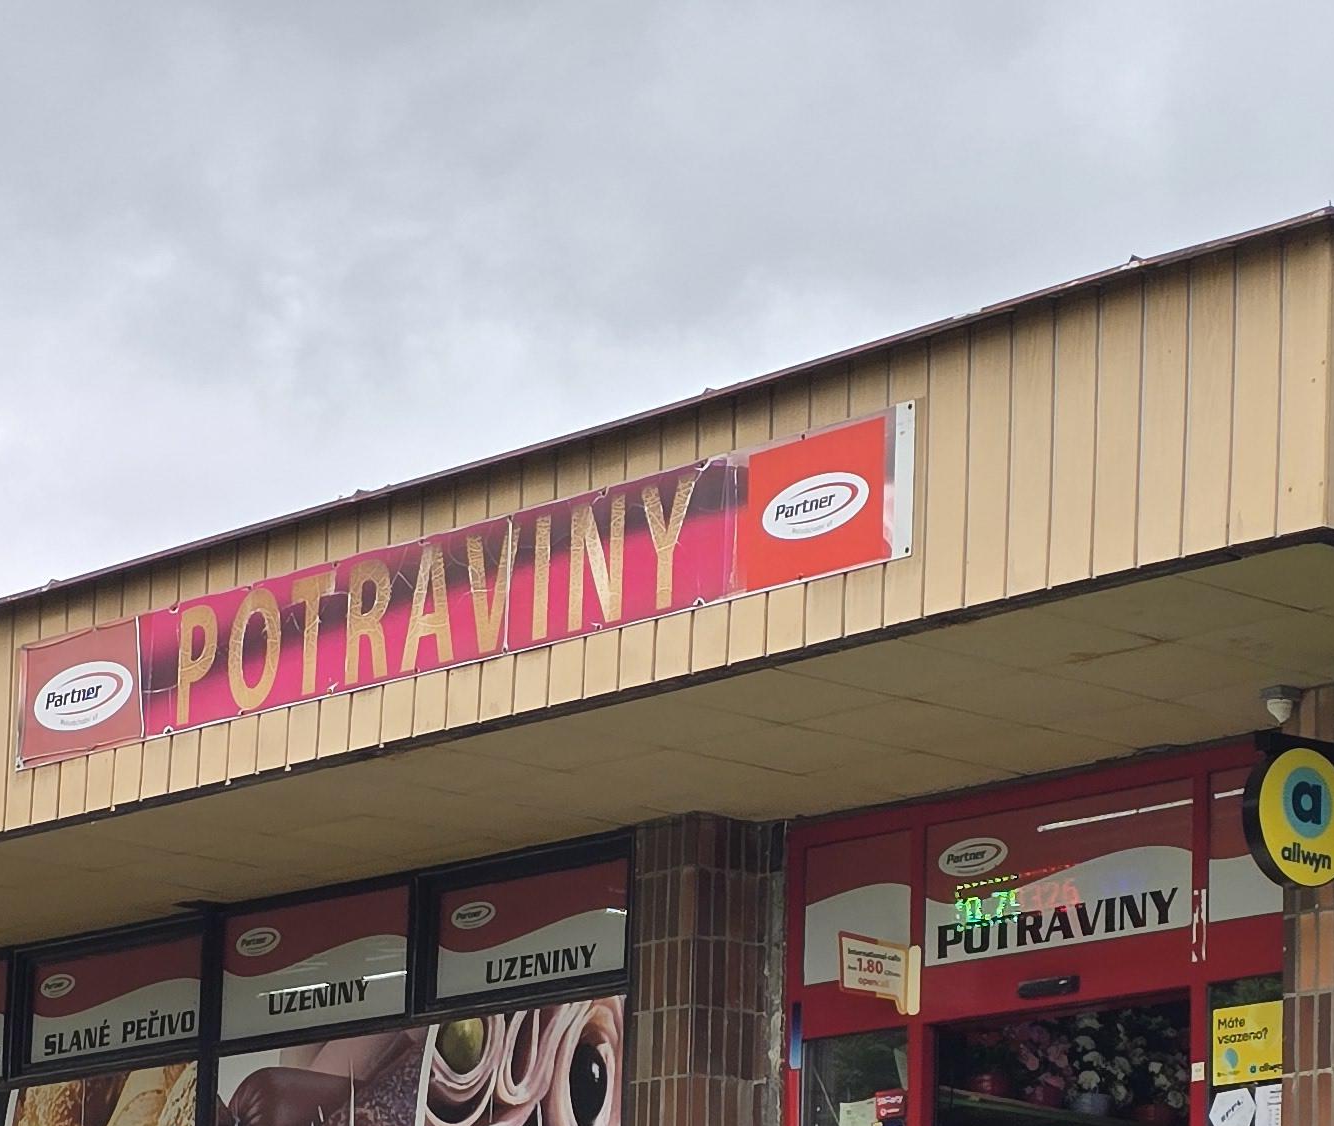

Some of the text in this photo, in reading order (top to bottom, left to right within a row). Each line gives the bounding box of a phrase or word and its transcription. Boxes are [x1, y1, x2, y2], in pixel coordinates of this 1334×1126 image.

[775, 494, 835, 521] Partner
[176, 475, 696, 726] POTRAVINY
[46, 685, 102, 710] Partner
[946, 849, 987, 865] Partner
[1281, 842, 1332, 873] allwyn
[937, 887, 1179, 959] POTRAVINY
[484, 943, 597, 985] UZENINY
[857, 957, 884, 975] 1.80
[268, 978, 368, 1016] UZENINY
[44, 1009, 196, 1057] SLANÉ PEČIVO
[1218, 1017, 1246, 1030] Máte
[1218, 1027, 1268, 1045] vsazeno?
